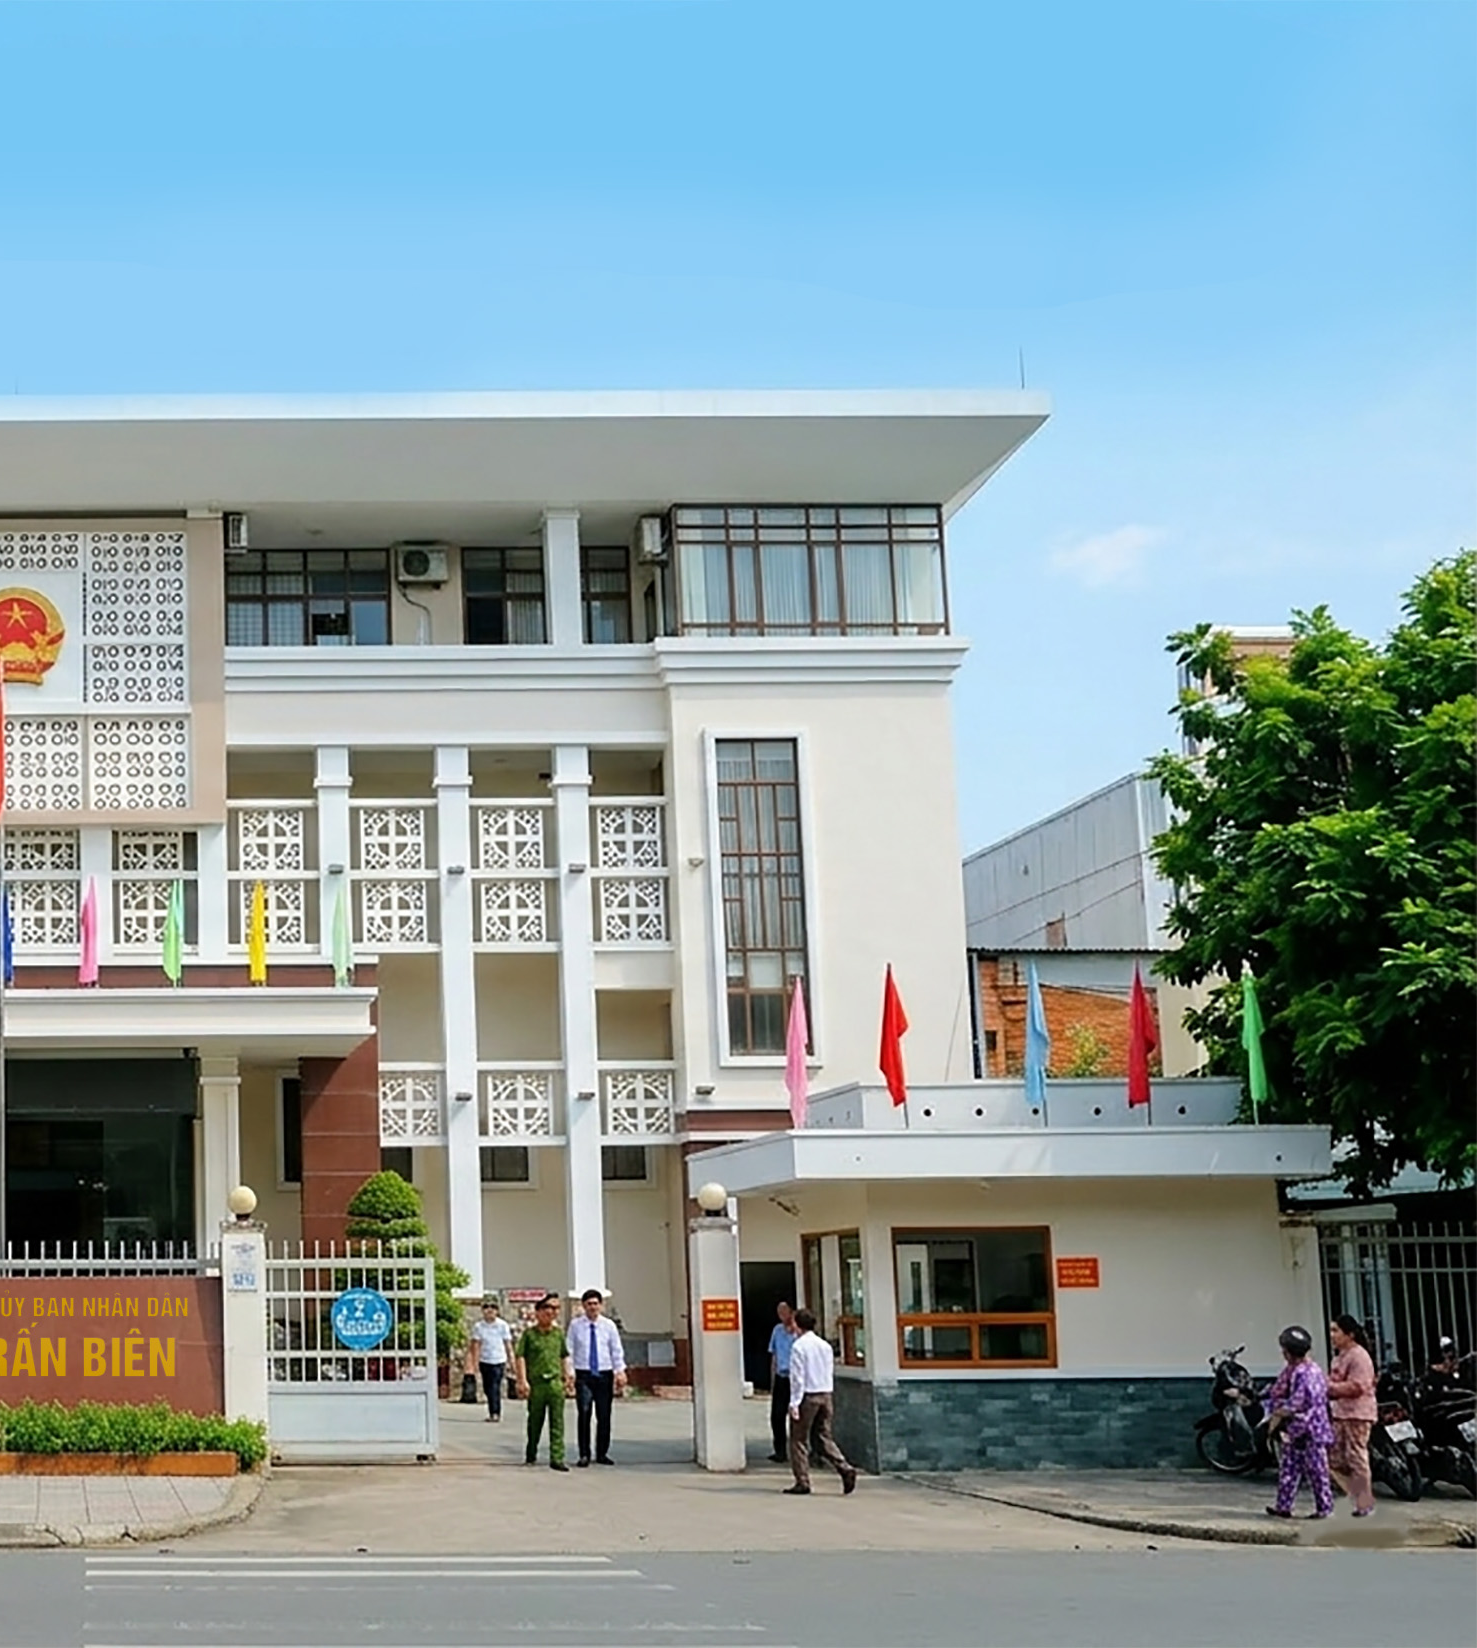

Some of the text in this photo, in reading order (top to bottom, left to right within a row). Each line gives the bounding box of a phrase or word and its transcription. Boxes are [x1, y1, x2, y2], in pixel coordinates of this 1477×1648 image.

[0, 1290, 25, 1317] ỦY
[33, 1297, 74, 1317] BAN
[83, 1292, 139, 1317] NHÂN
[147, 1292, 188, 1317] DÂN
[83, 1328, 176, 1377] BIÊN
